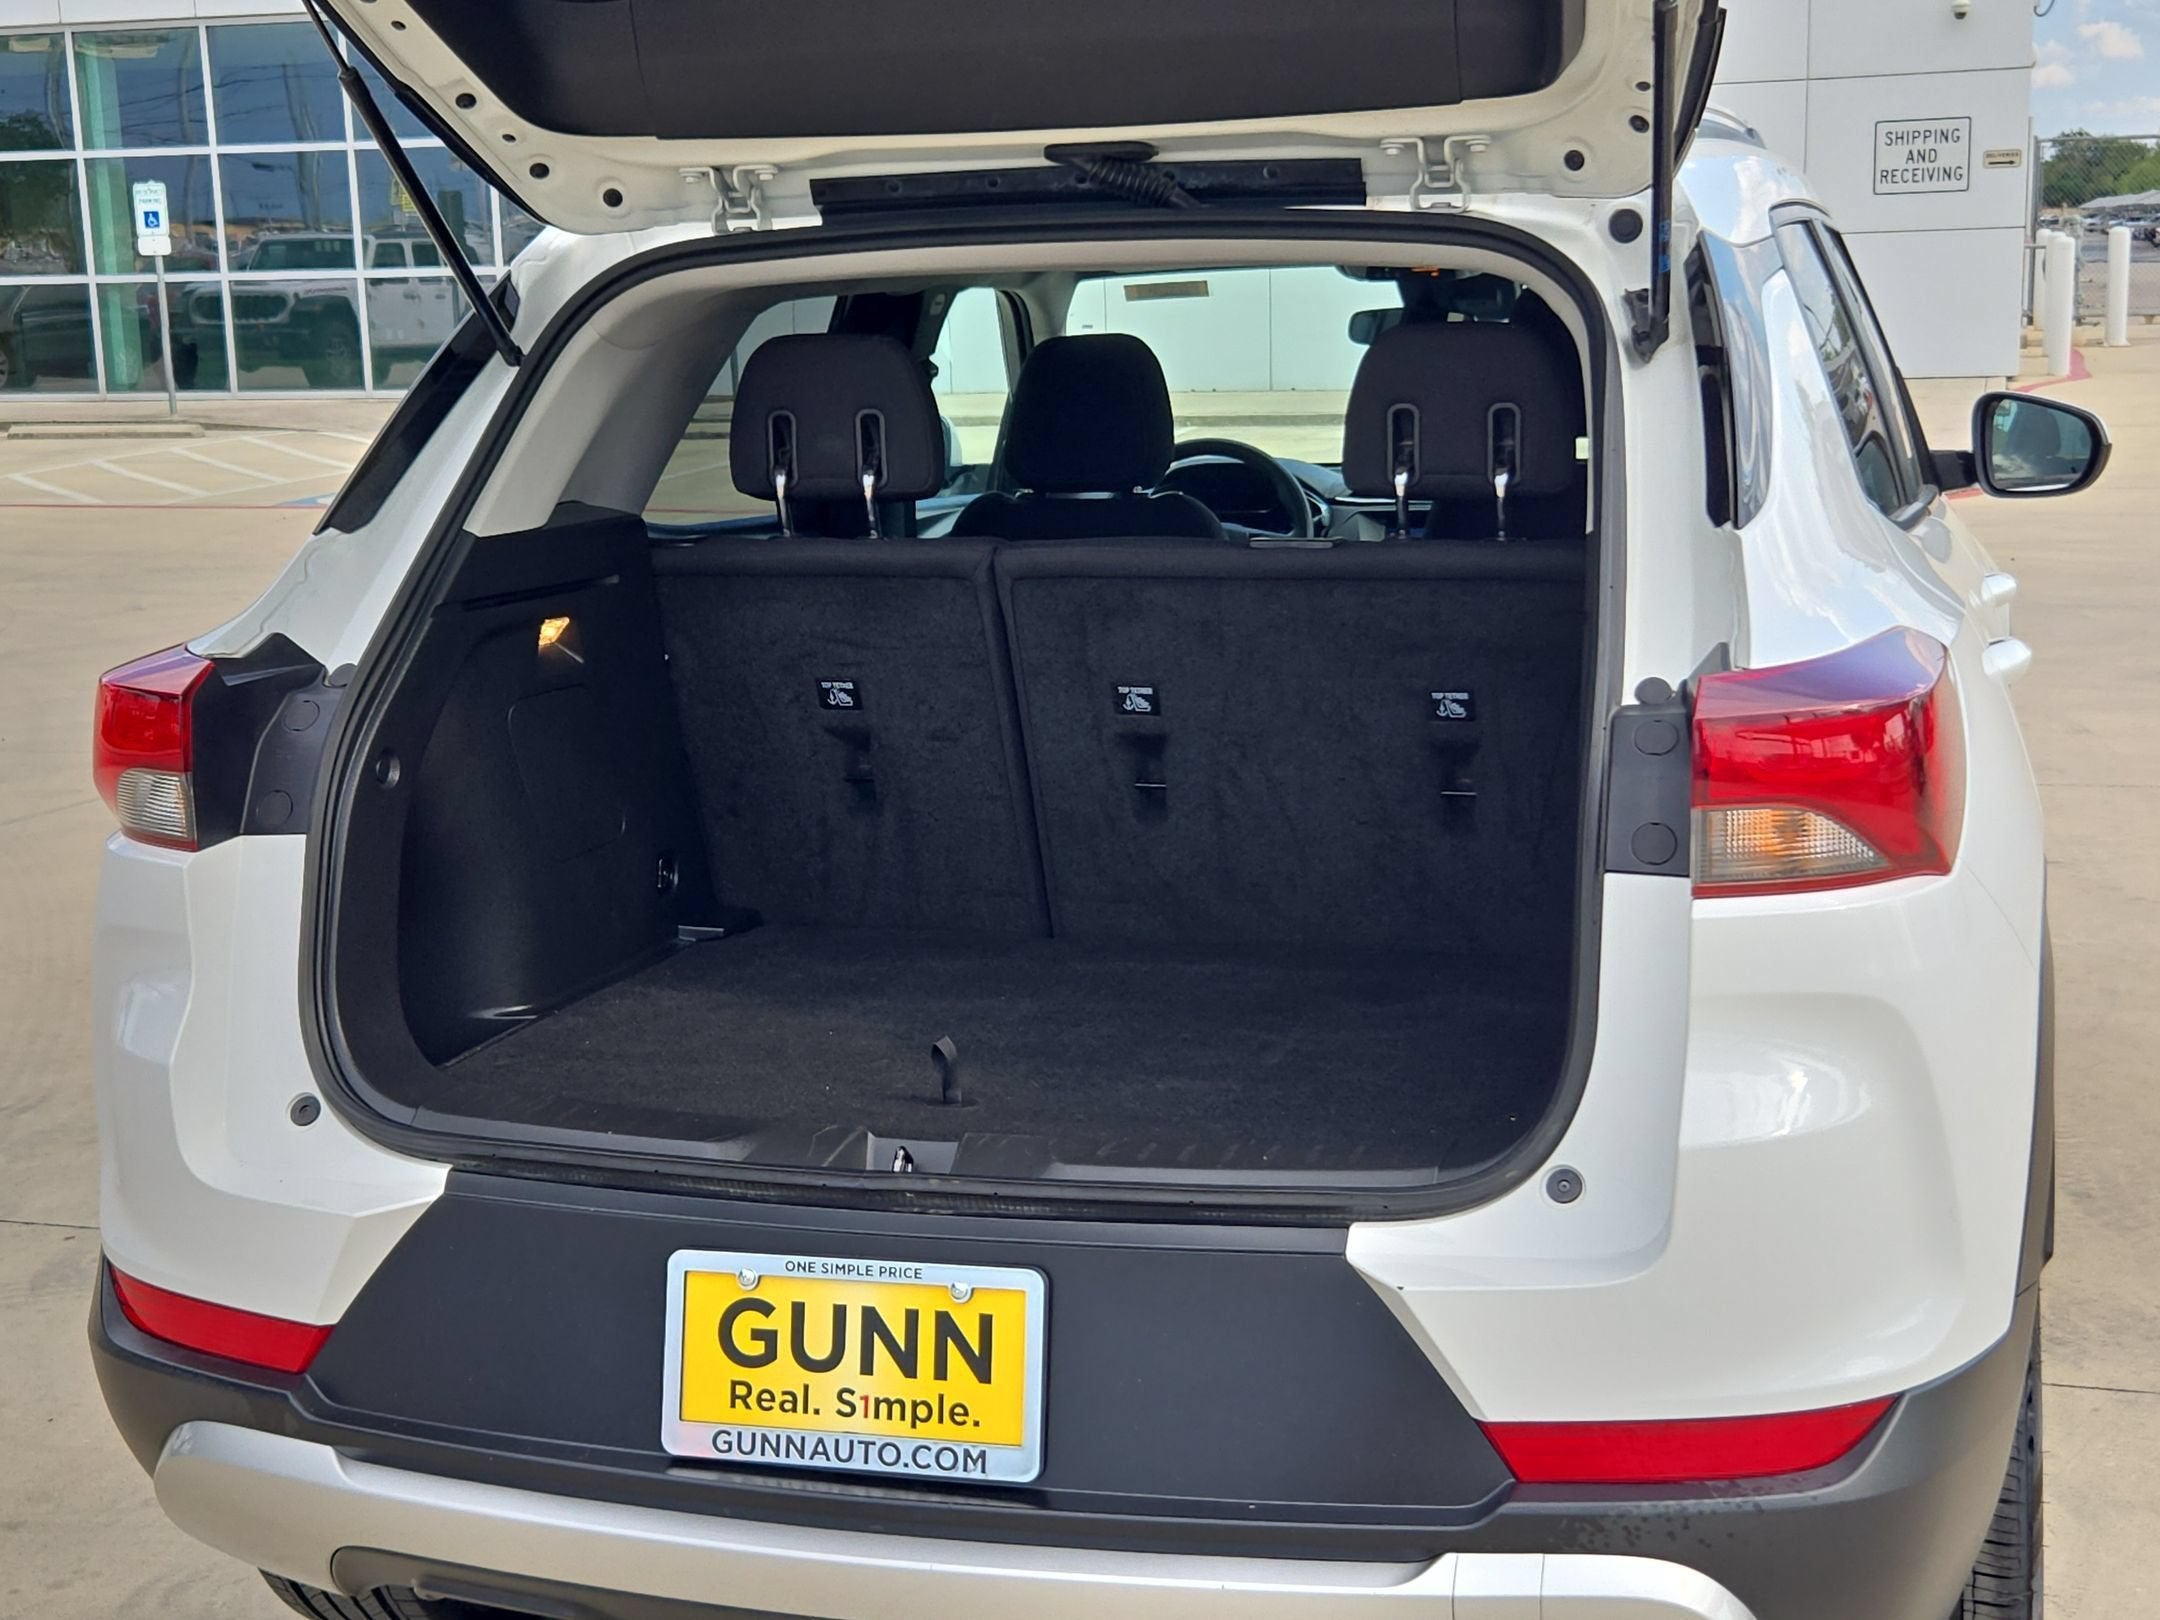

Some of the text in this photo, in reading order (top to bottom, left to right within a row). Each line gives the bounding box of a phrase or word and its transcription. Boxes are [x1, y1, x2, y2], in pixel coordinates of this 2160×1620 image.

[1884, 128, 1961, 147] SHIPPING
[1905, 148, 1938, 165] AND
[1880, 166, 1964, 185] RECEIVING
[785, 1260, 923, 1280] ONE SIMPLE PRICE
[717, 1297, 993, 1385] GUNN
[729, 1379, 820, 1416] Real.
[711, 1429, 987, 1474] GUNNAUTO.COM
